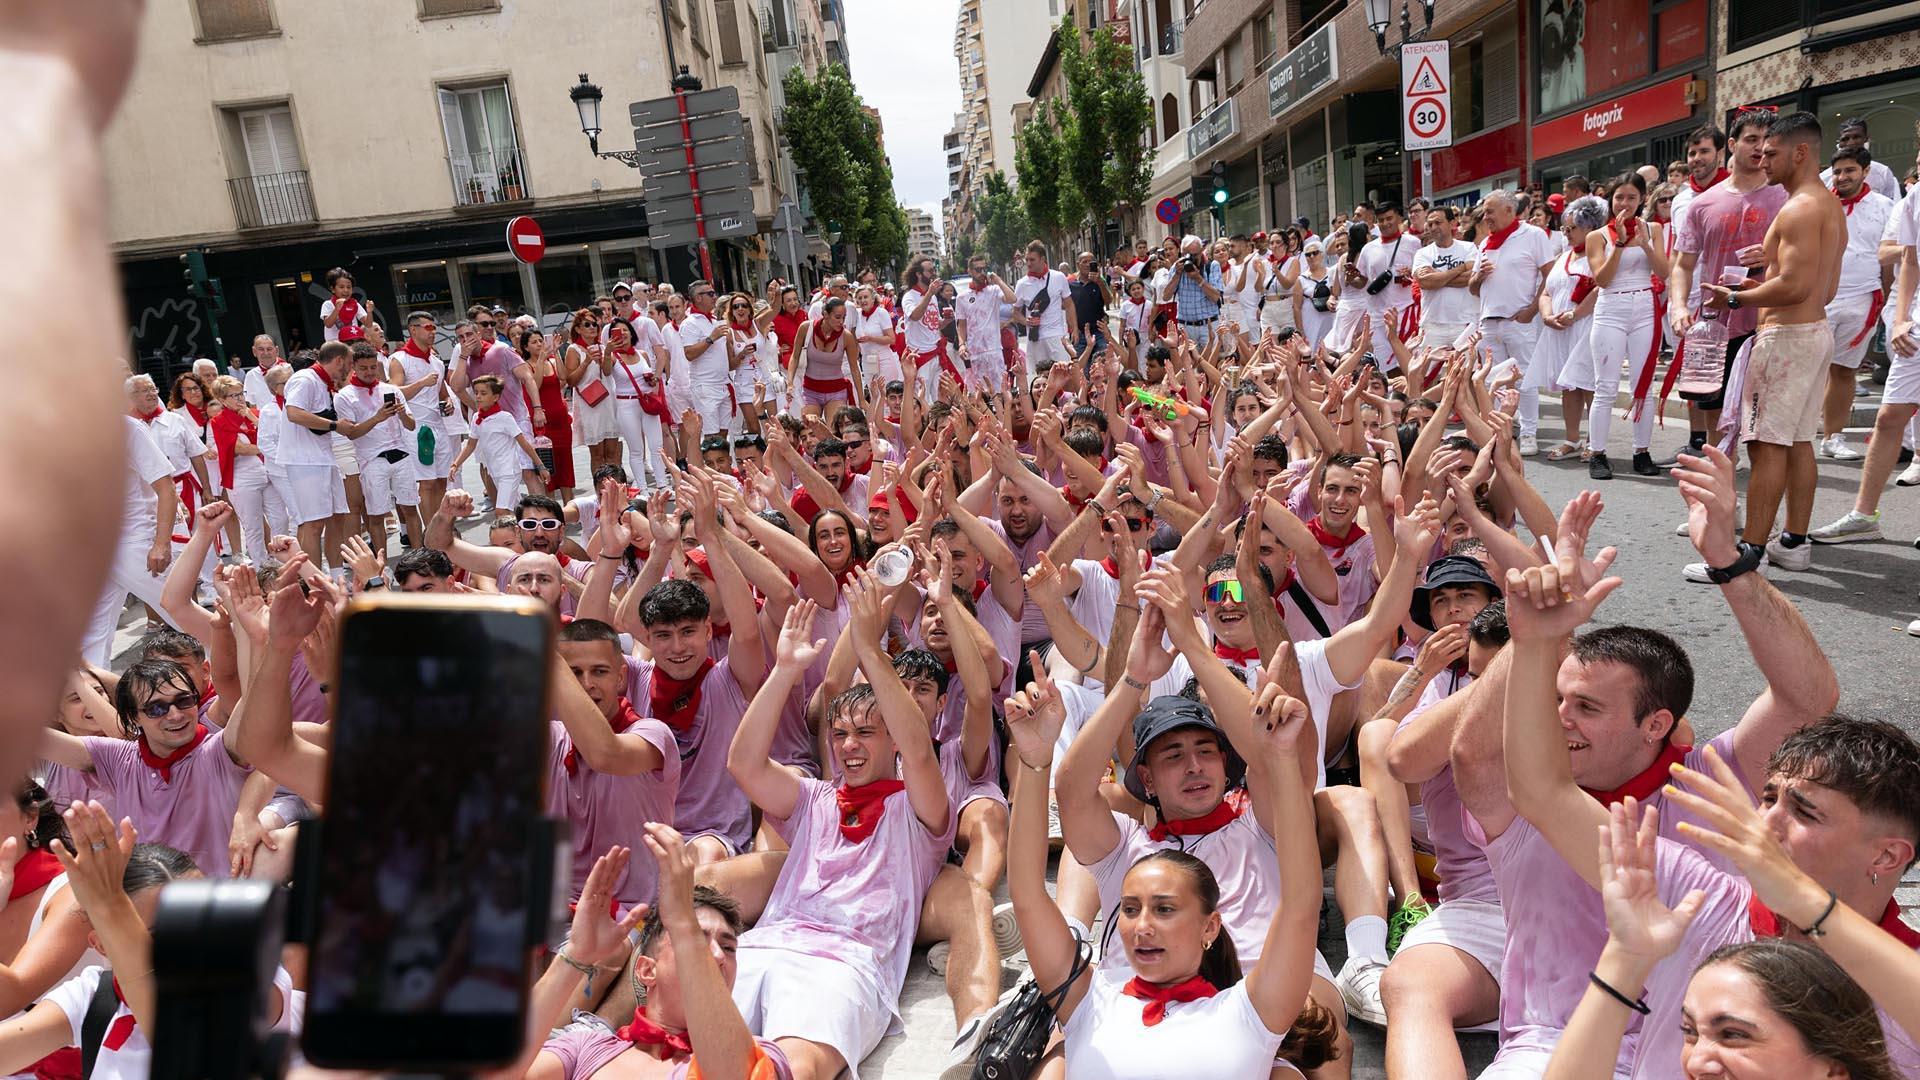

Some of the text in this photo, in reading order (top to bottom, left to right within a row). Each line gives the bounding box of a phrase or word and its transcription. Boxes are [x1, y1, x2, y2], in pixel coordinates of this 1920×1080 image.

[1404, 44, 1447, 55] ATENCIÓN
[1417, 111, 1438, 125] 30
[1583, 103, 1624, 132] fotoprix
[1436, 254, 1453, 263] JUST
